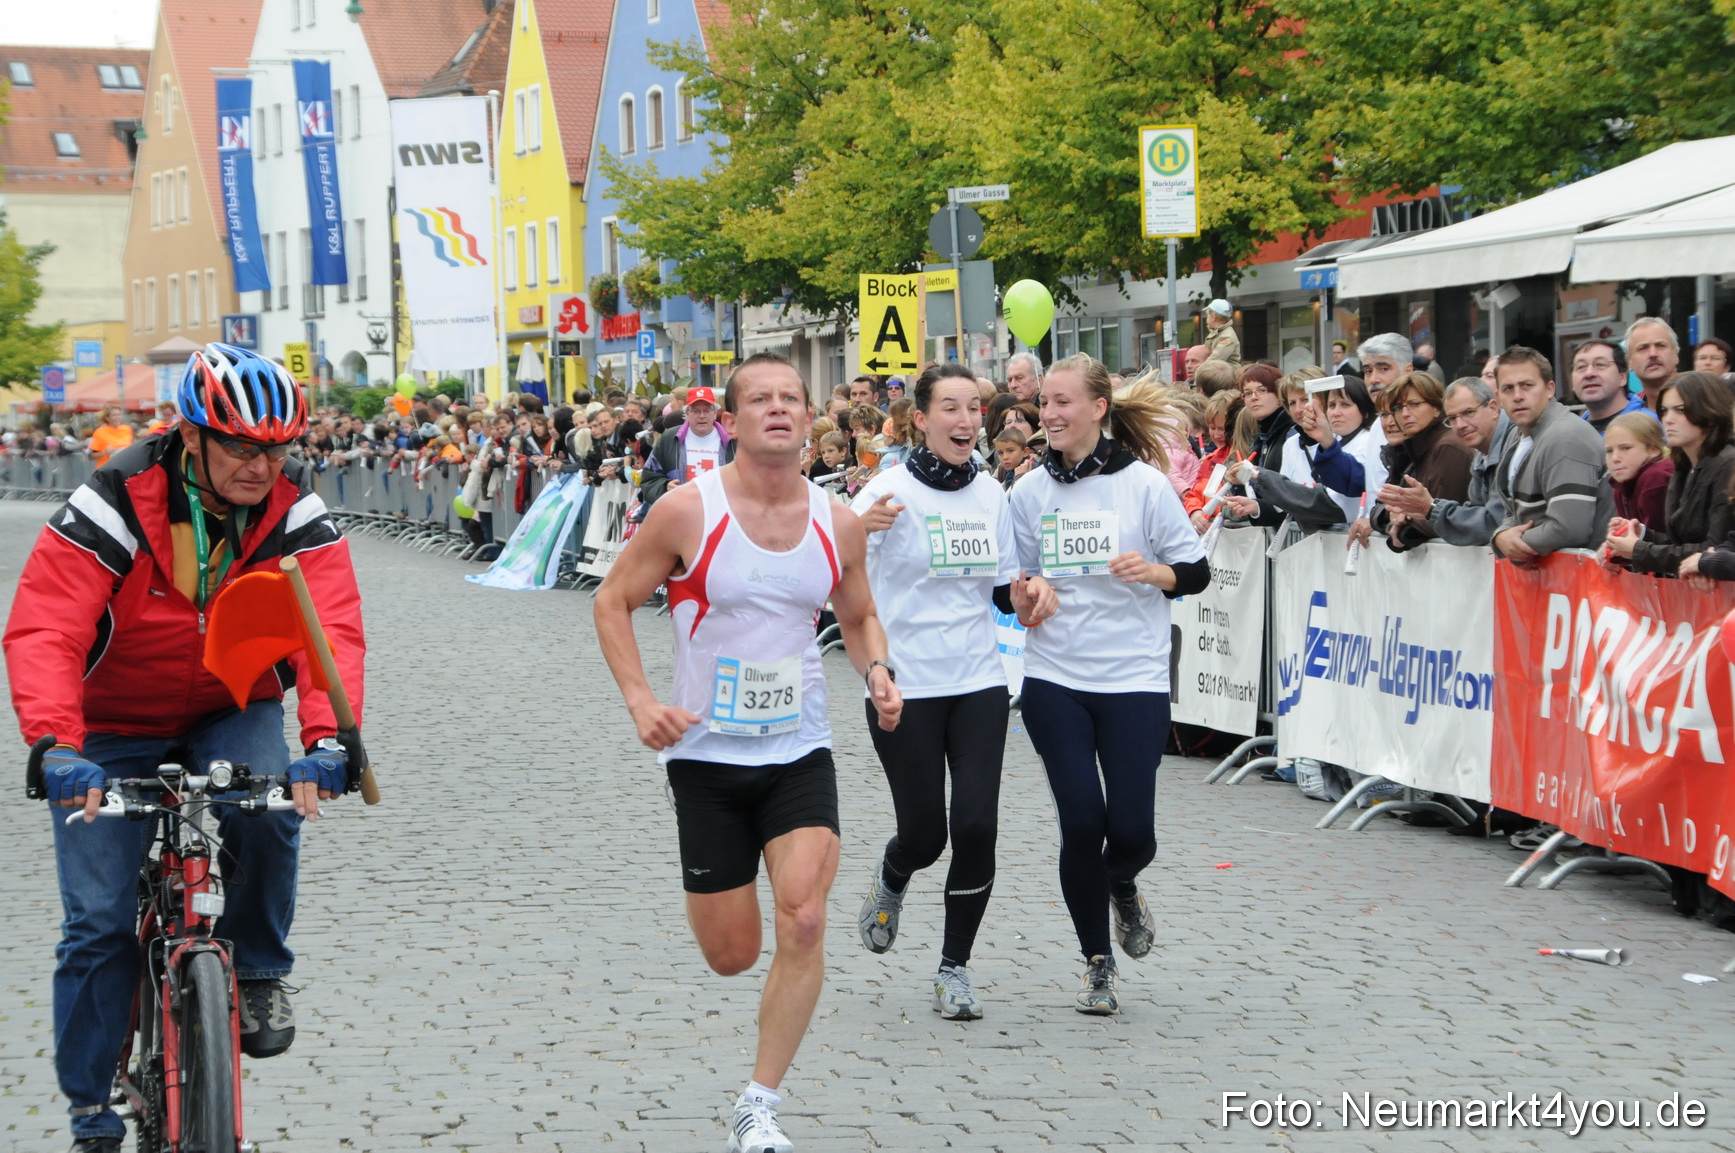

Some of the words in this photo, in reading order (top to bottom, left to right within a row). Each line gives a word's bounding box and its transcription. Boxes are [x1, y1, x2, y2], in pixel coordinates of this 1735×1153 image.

[1158, 143, 1179, 167] H
[316, 143, 338, 221] RUPPERT
[1152, 180, 1188, 188] Marktplatz
[958, 190, 981, 200] Ulmer
[983, 188, 1006, 199] Gasse
[867, 278, 918, 298] Block
[872, 305, 911, 354] A
[285, 343, 307, 351] Block
[641, 334, 651, 356] P
[291, 355, 305, 374] B
[945, 519, 987, 533] Stephanie
[1061, 518, 1101, 530] Theresa
[951, 538, 991, 557] 5001
[1063, 536, 1112, 556] 5004
[1198, 602, 1212, 623] Im
[1198, 630, 1215, 652] der
[745, 667, 779, 682] Oliver
[721, 685, 727, 695] A
[743, 685, 794, 709] 3278
